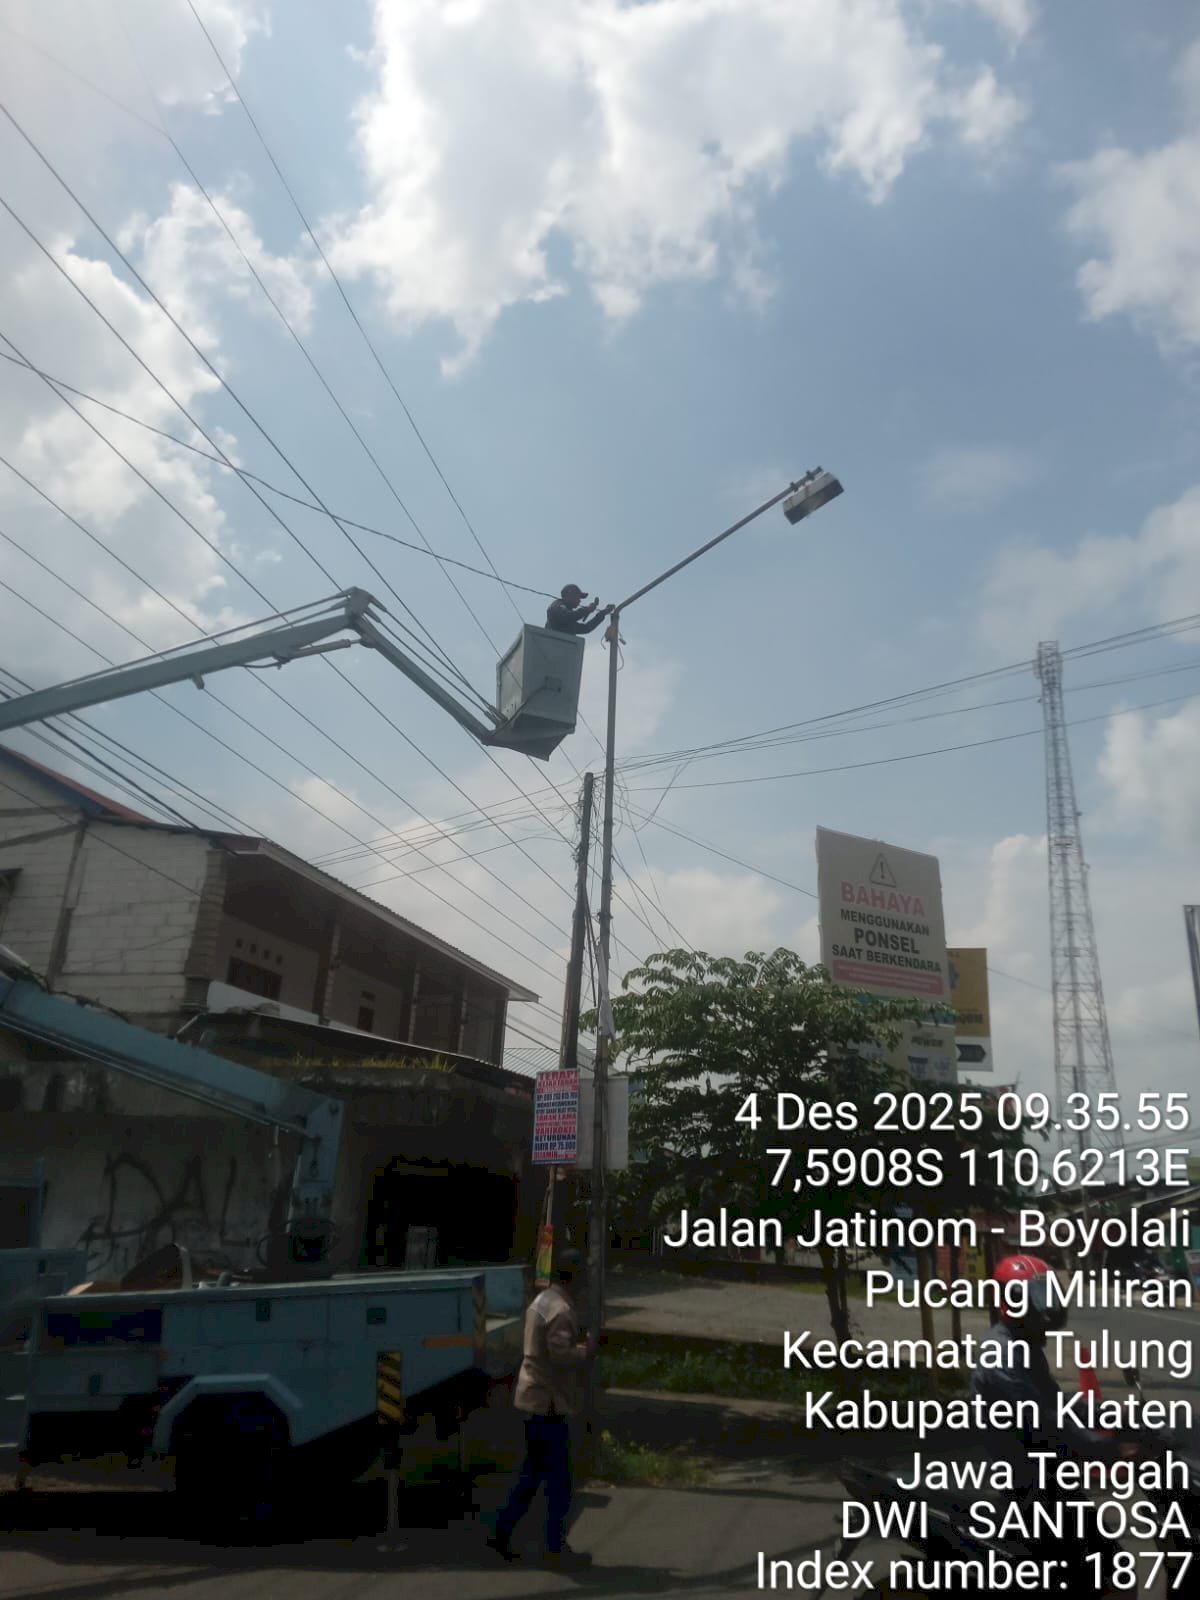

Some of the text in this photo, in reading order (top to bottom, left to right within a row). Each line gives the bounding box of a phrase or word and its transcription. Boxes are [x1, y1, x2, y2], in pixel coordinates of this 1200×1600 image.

[840, 880, 926, 918] BAHAYA
[840, 908, 930, 937] MENGGUNAKAN
[854, 927, 920, 955] PONSEL
[831, 943, 863, 960] SAAT
[866, 949, 942, 974] BERKENDARA
